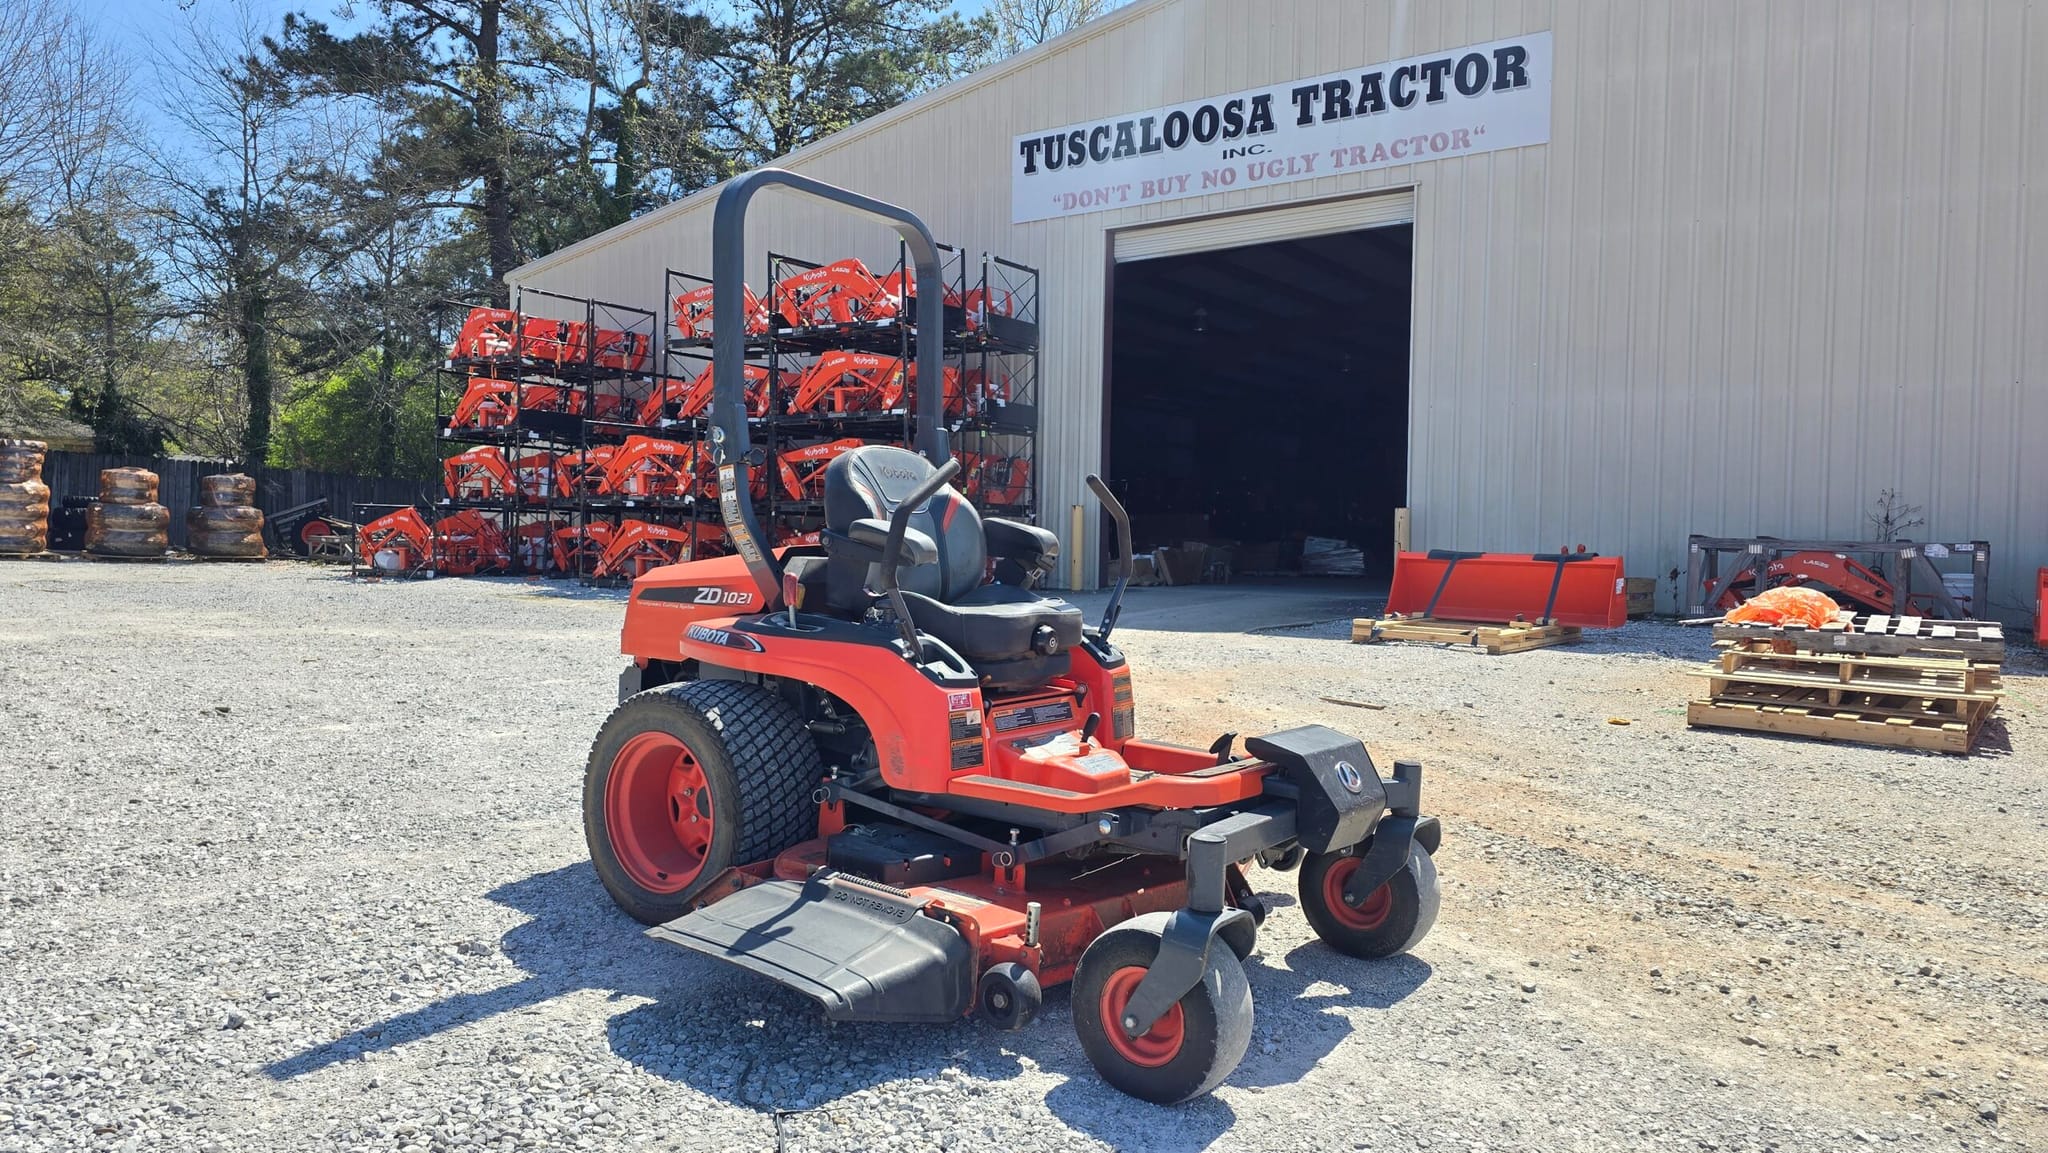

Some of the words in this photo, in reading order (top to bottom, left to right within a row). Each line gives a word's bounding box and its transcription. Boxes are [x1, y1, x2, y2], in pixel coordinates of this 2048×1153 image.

[1020, 93, 1277, 175] TUSCALOOSA
[1292, 45, 1529, 127] TRACTOR
[1222, 144, 1273, 160] INC.
[1140, 174, 1191, 199] BUY
[1201, 167, 1237, 189] NO
[1247, 152, 1319, 181] UGLY
[803, 270, 827, 281] Kubota
[853, 356, 879, 366] Kubota
[652, 442, 675, 452] Kubota
[804, 446, 829, 457] Kubota
[879, 465, 918, 482] Kubota
[647, 525, 669, 536] Kubota
[805, 531, 820, 544] Kub
[1747, 562, 1784, 577] Kota
[693, 587, 721, 604] ZD
[722, 592, 753, 604] 1021
[687, 625, 730, 645] KUBOTA
[834, 891, 848, 901] DO
[850, 895, 869, 908] NOT
[870, 900, 905, 918] REMOVE
